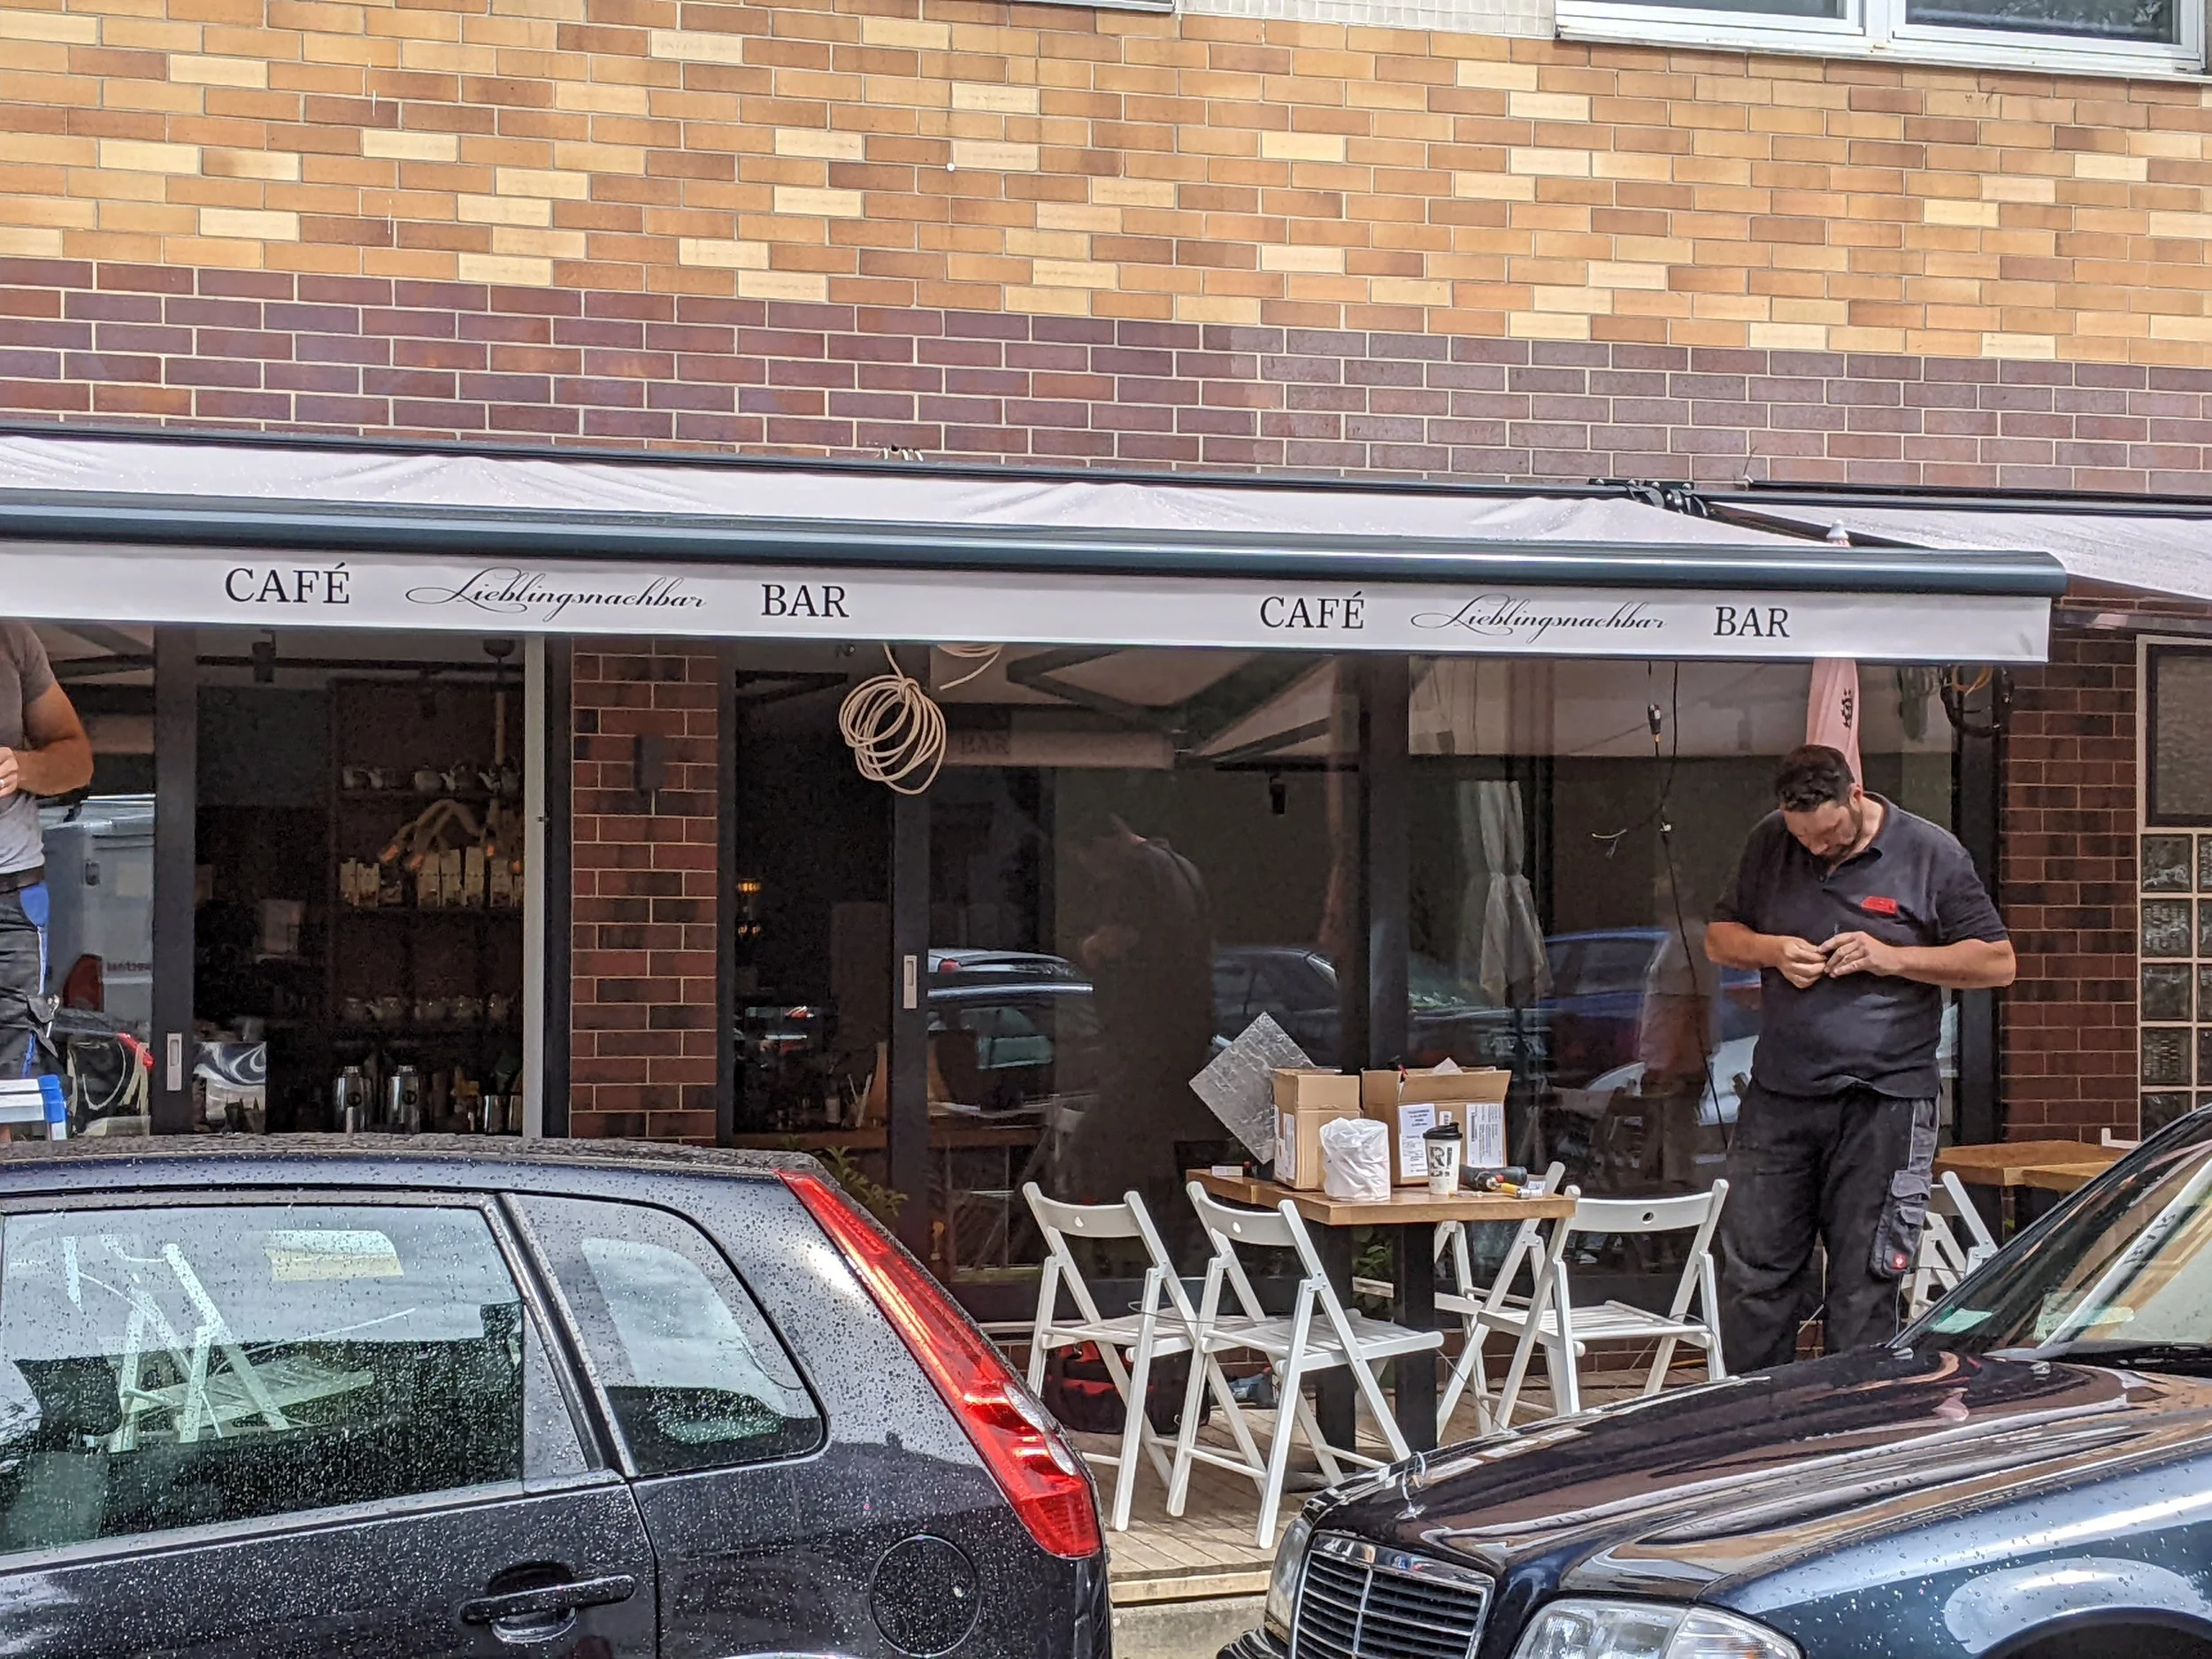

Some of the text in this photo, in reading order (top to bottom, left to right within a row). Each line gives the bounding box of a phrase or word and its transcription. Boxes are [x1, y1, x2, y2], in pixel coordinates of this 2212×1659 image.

[225, 561, 850, 623] CAFÉ Lieblingsnachbar BAR
[1259, 590, 1791, 645] CAFÉ Lieblingsnachbar BAR
